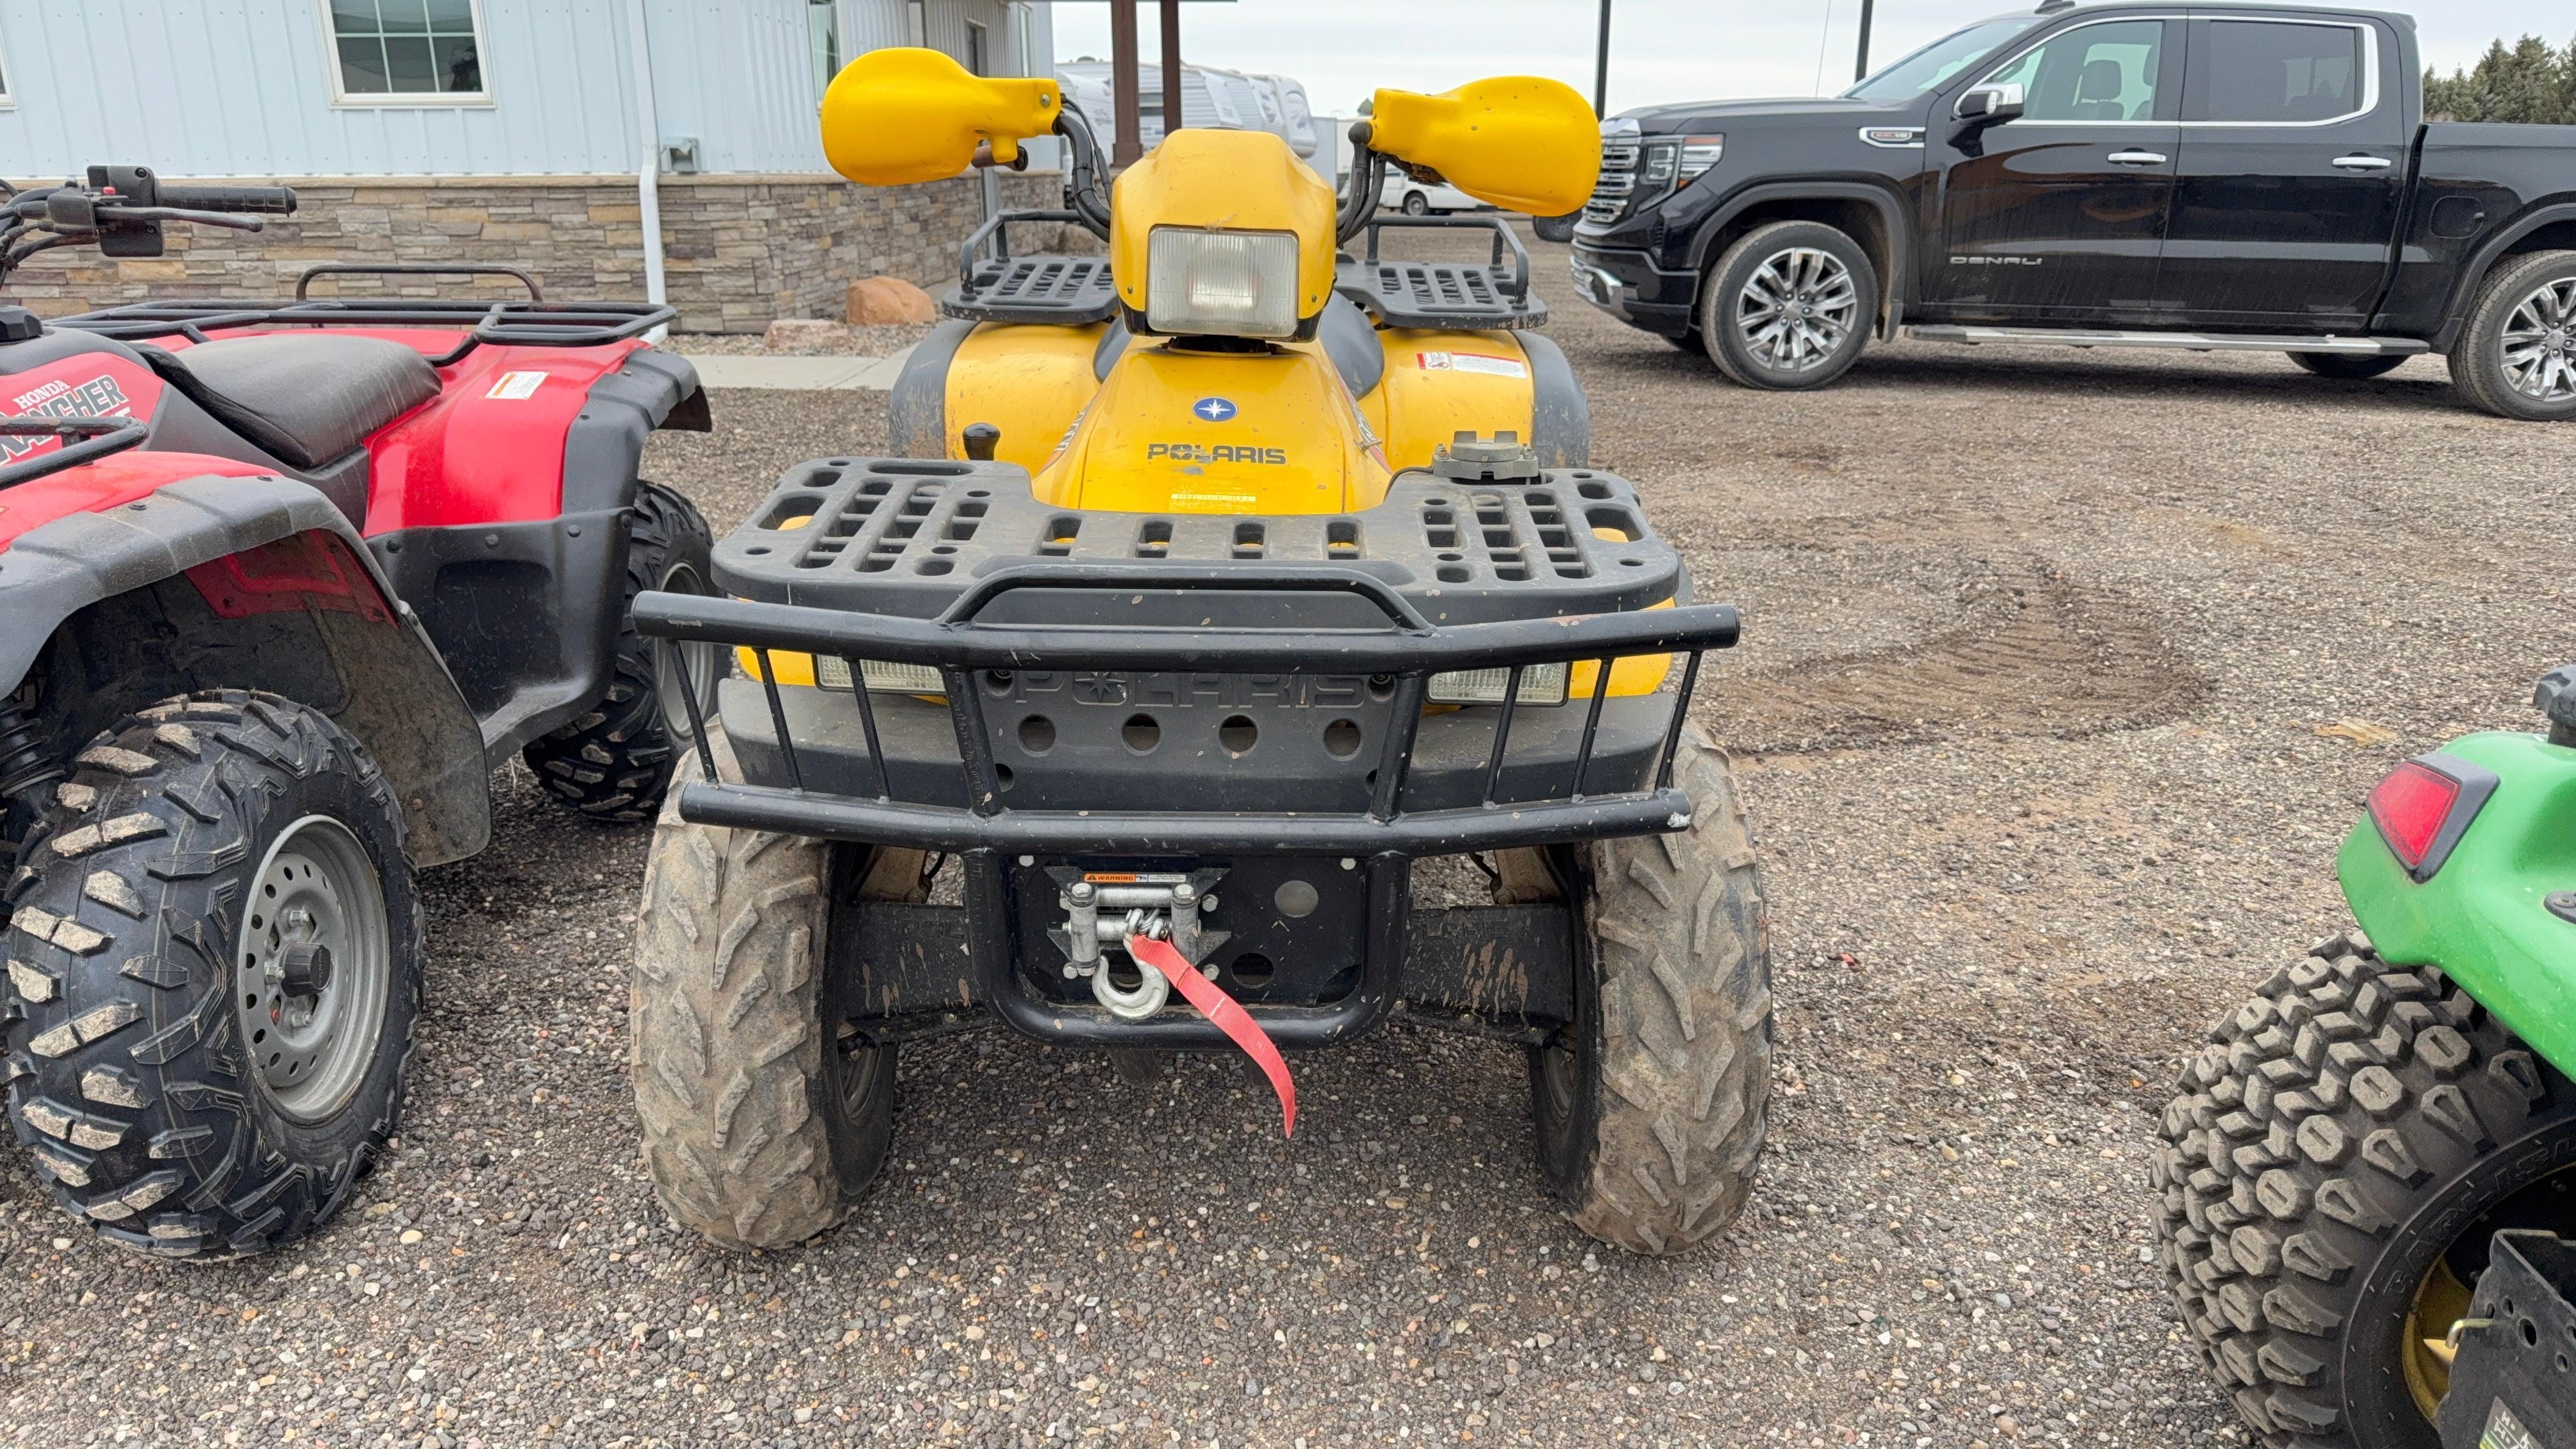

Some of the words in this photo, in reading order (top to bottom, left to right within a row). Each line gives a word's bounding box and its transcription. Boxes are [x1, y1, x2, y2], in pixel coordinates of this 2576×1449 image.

[1950, 257, 2042, 265] DENALI
[12, 379, 71, 409] HONDA
[1147, 443, 1287, 465] POLARIS
[1015, 671, 1365, 707] POLARIS
